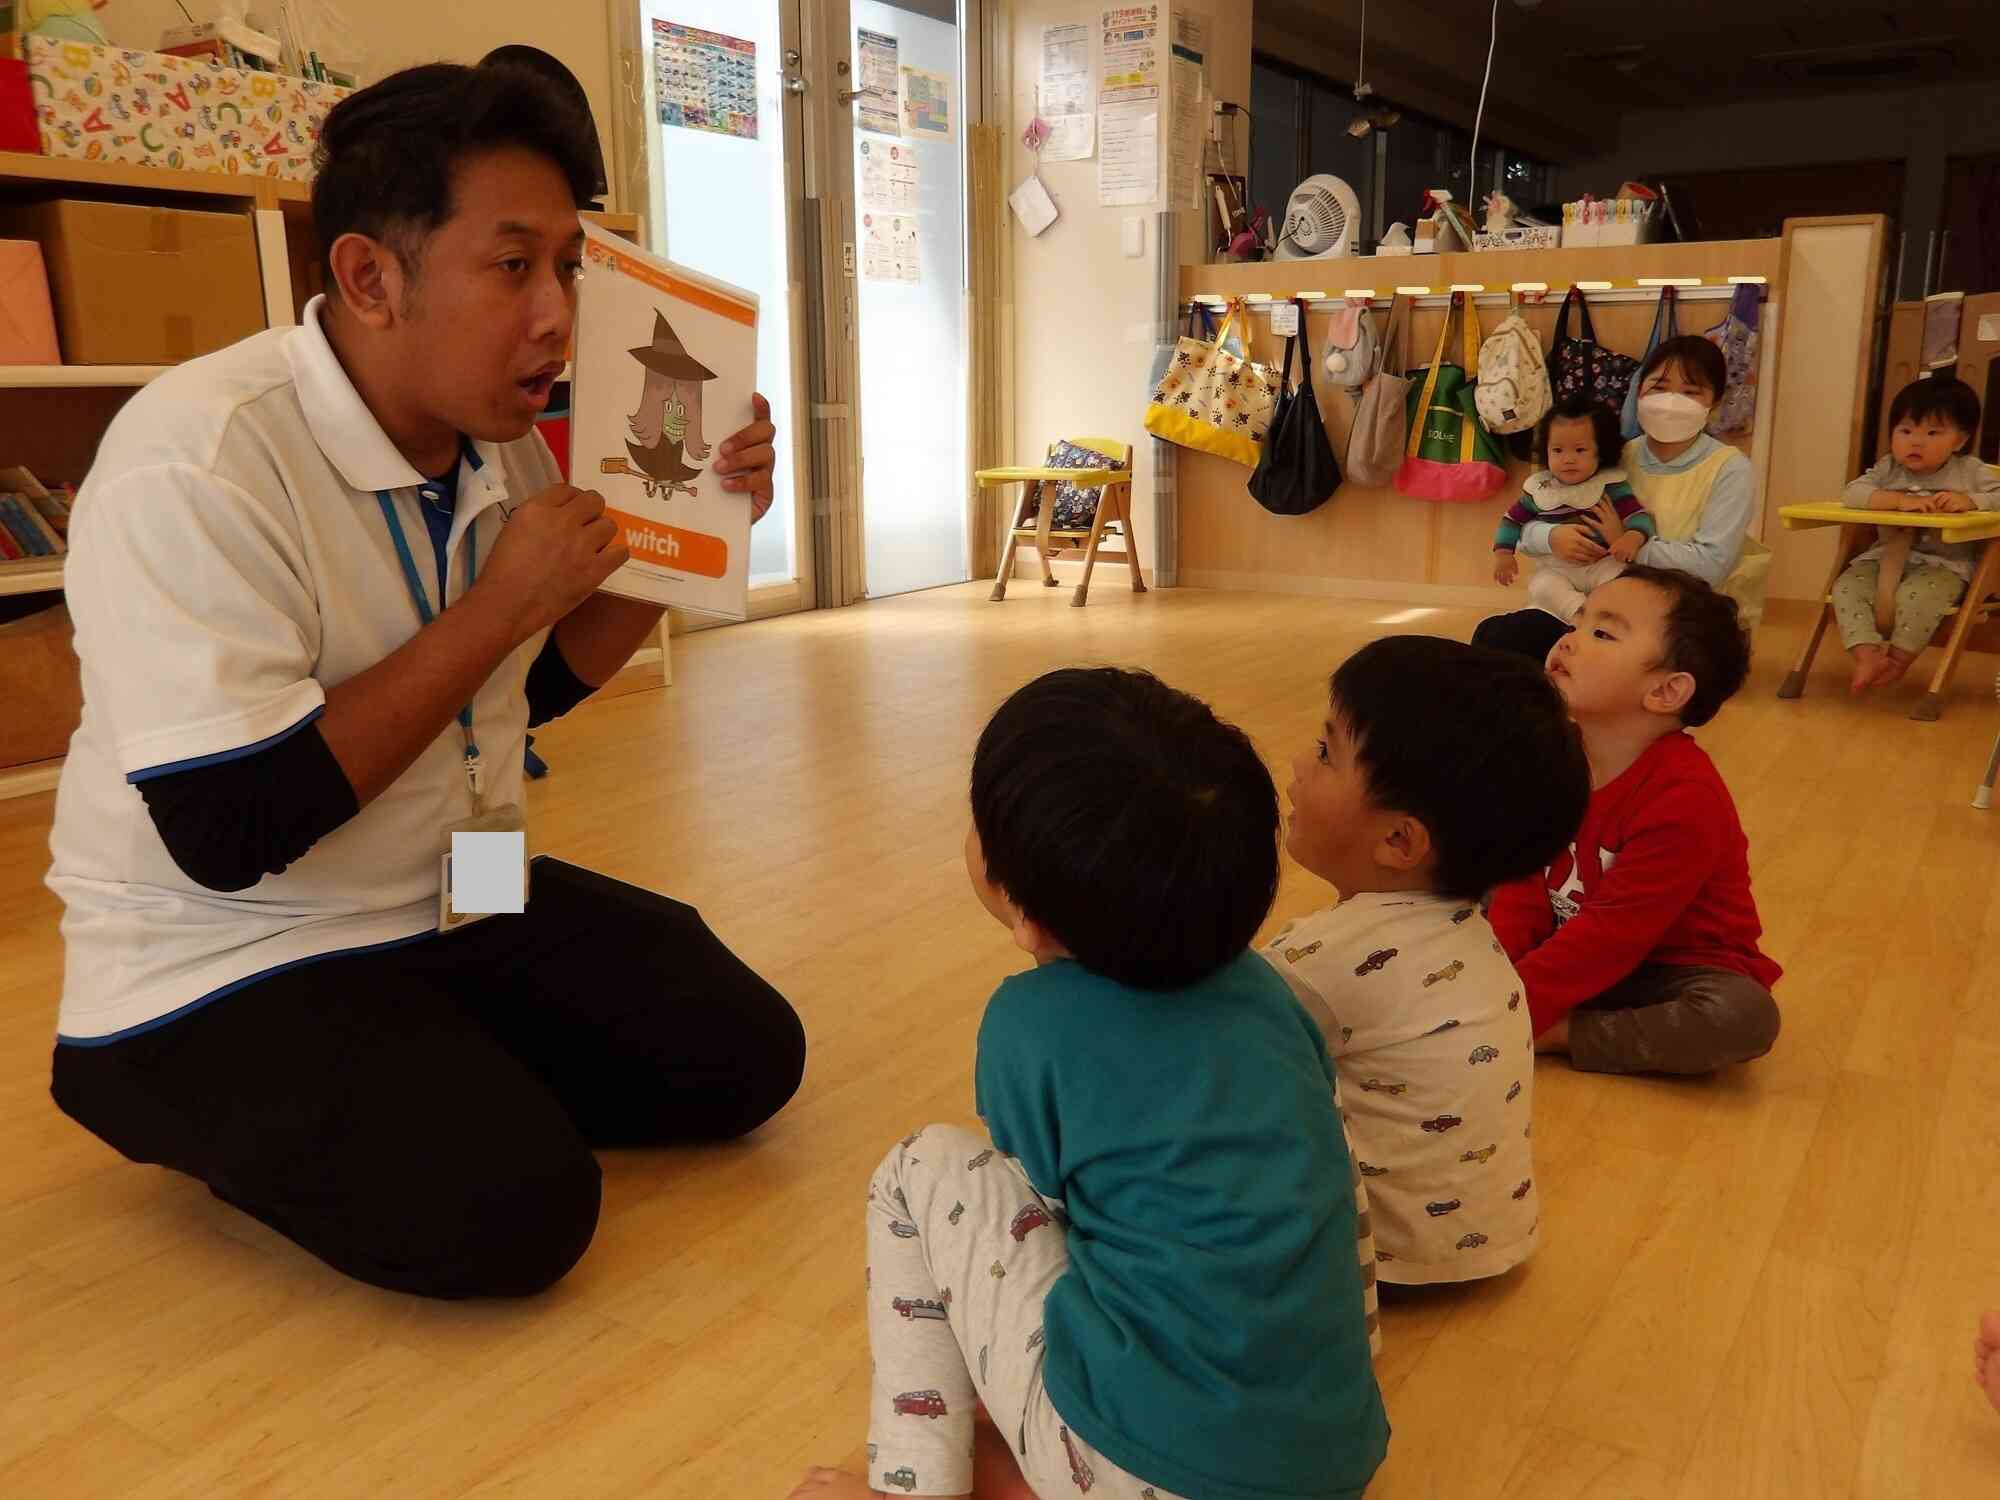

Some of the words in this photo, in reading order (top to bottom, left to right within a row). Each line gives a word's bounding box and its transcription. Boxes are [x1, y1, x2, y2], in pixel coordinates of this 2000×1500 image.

[165, 80, 191, 112] A
[83, 106, 113, 133] A
[264, 131, 288, 155] A
[625, 527, 680, 558] witch
